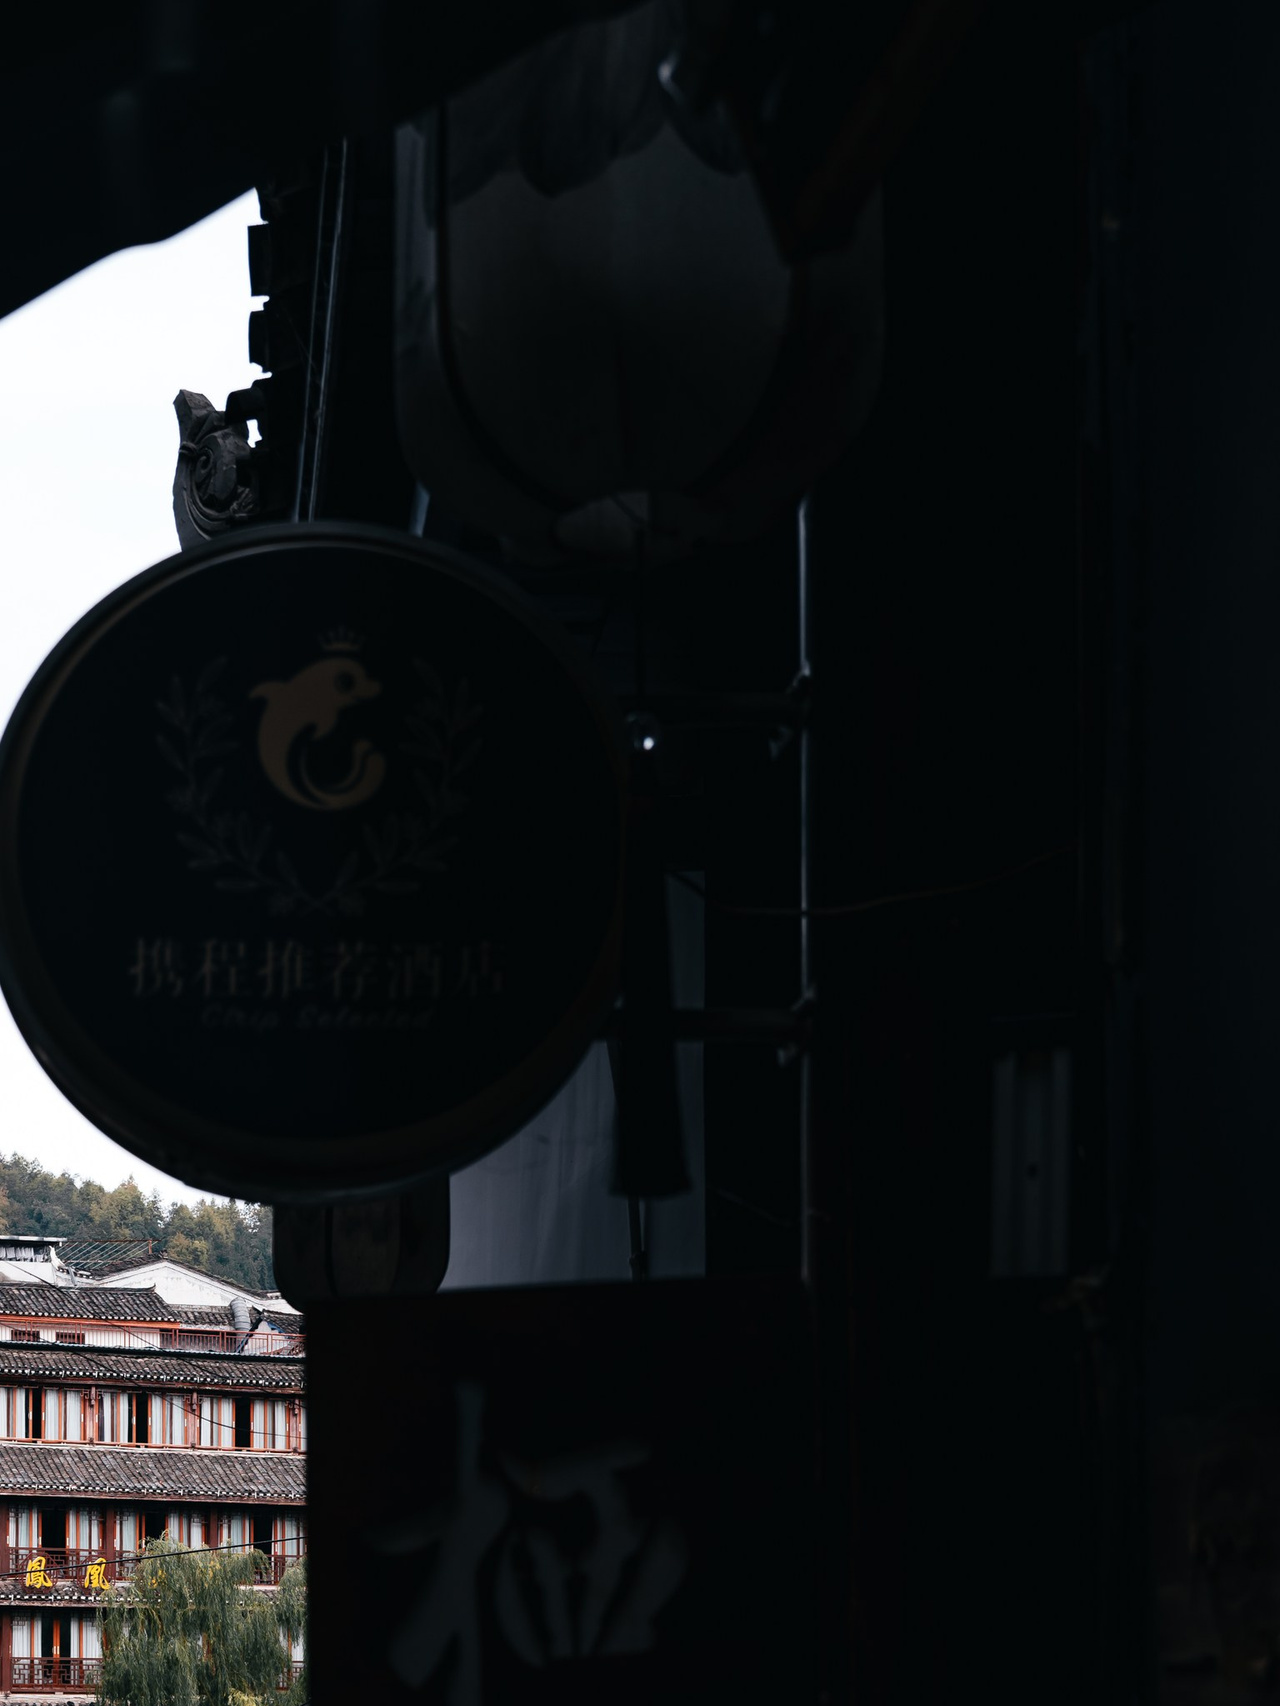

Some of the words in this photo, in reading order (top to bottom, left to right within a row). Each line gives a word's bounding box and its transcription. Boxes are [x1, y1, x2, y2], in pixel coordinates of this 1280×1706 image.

[128, 935, 507, 999] 携程推荐酒店
